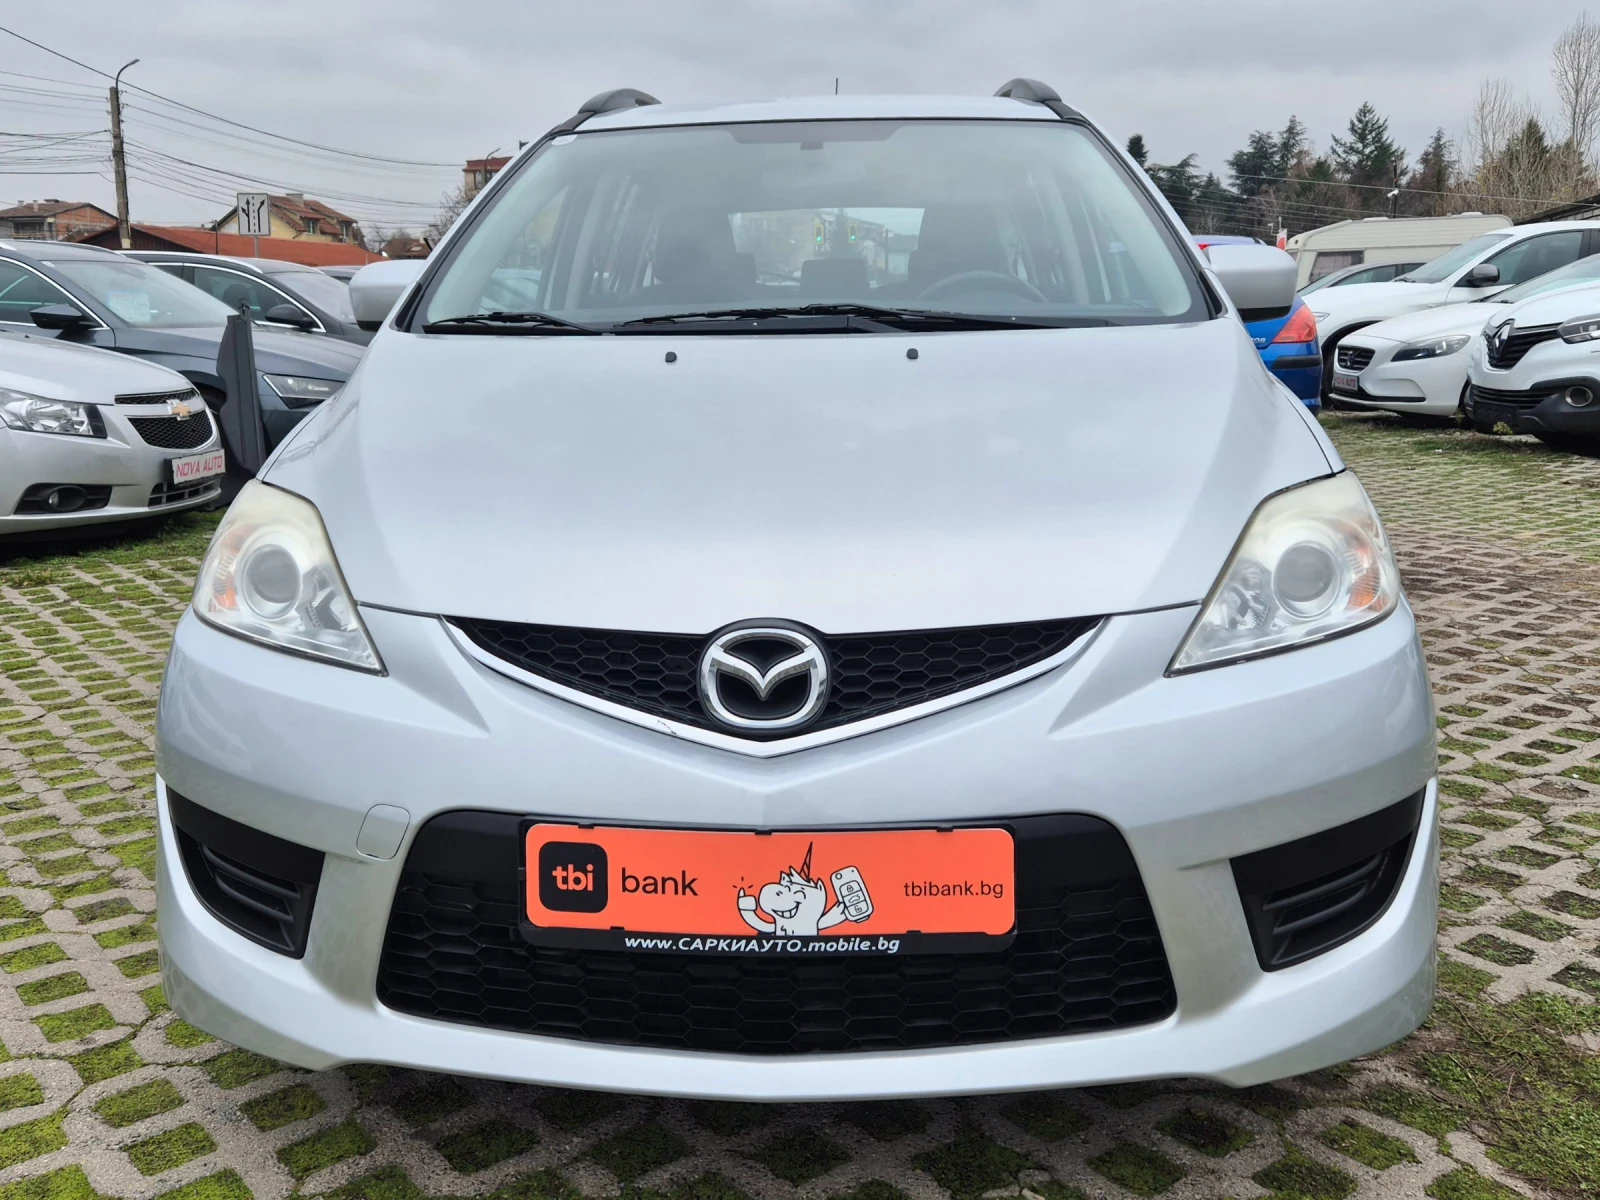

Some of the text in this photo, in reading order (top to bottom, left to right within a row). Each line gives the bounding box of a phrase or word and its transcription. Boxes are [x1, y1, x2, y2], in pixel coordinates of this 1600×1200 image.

[176, 455, 223, 478] NOVA AUTO
[552, 864, 699, 897] tbi bank
[903, 880, 1004, 898] tbibank.bg
[624, 937, 900, 954] www.САРКИАУТО.mobile.bg
